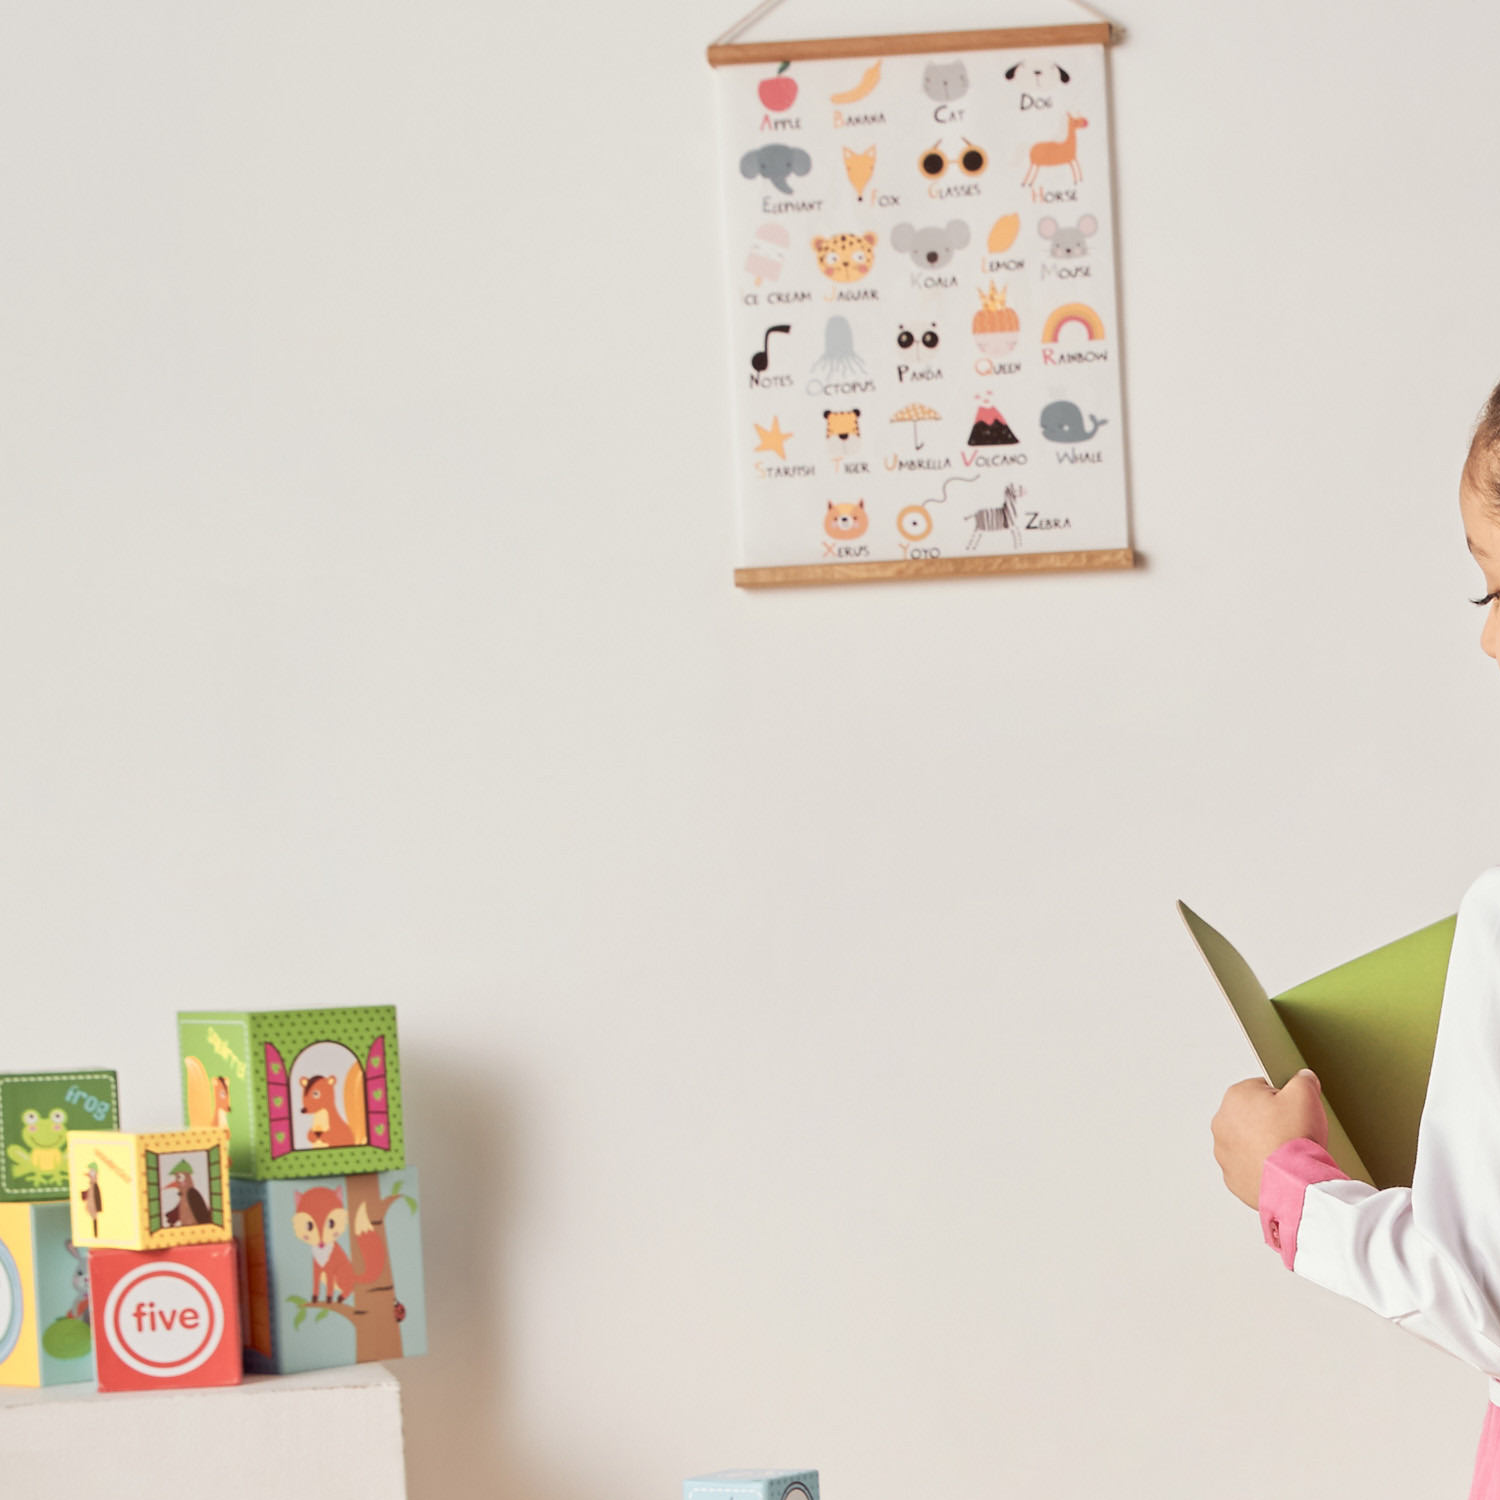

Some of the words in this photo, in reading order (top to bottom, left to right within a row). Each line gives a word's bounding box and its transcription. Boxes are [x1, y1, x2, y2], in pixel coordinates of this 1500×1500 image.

[933, 104, 964, 123] CAT
[1042, 348, 1108, 366] RAINBOW
[897, 364, 943, 383] PANDA
[974, 357, 1021, 376] QUEEN
[884, 454, 952, 471] UMBRELLA
[961, 449, 1028, 467] VOLCANO
[1056, 447, 1103, 465] WHALE
[1025, 512, 1072, 530] ZEBRA
[65, 1084, 110, 1121] frog
[133, 1303, 200, 1332] five
